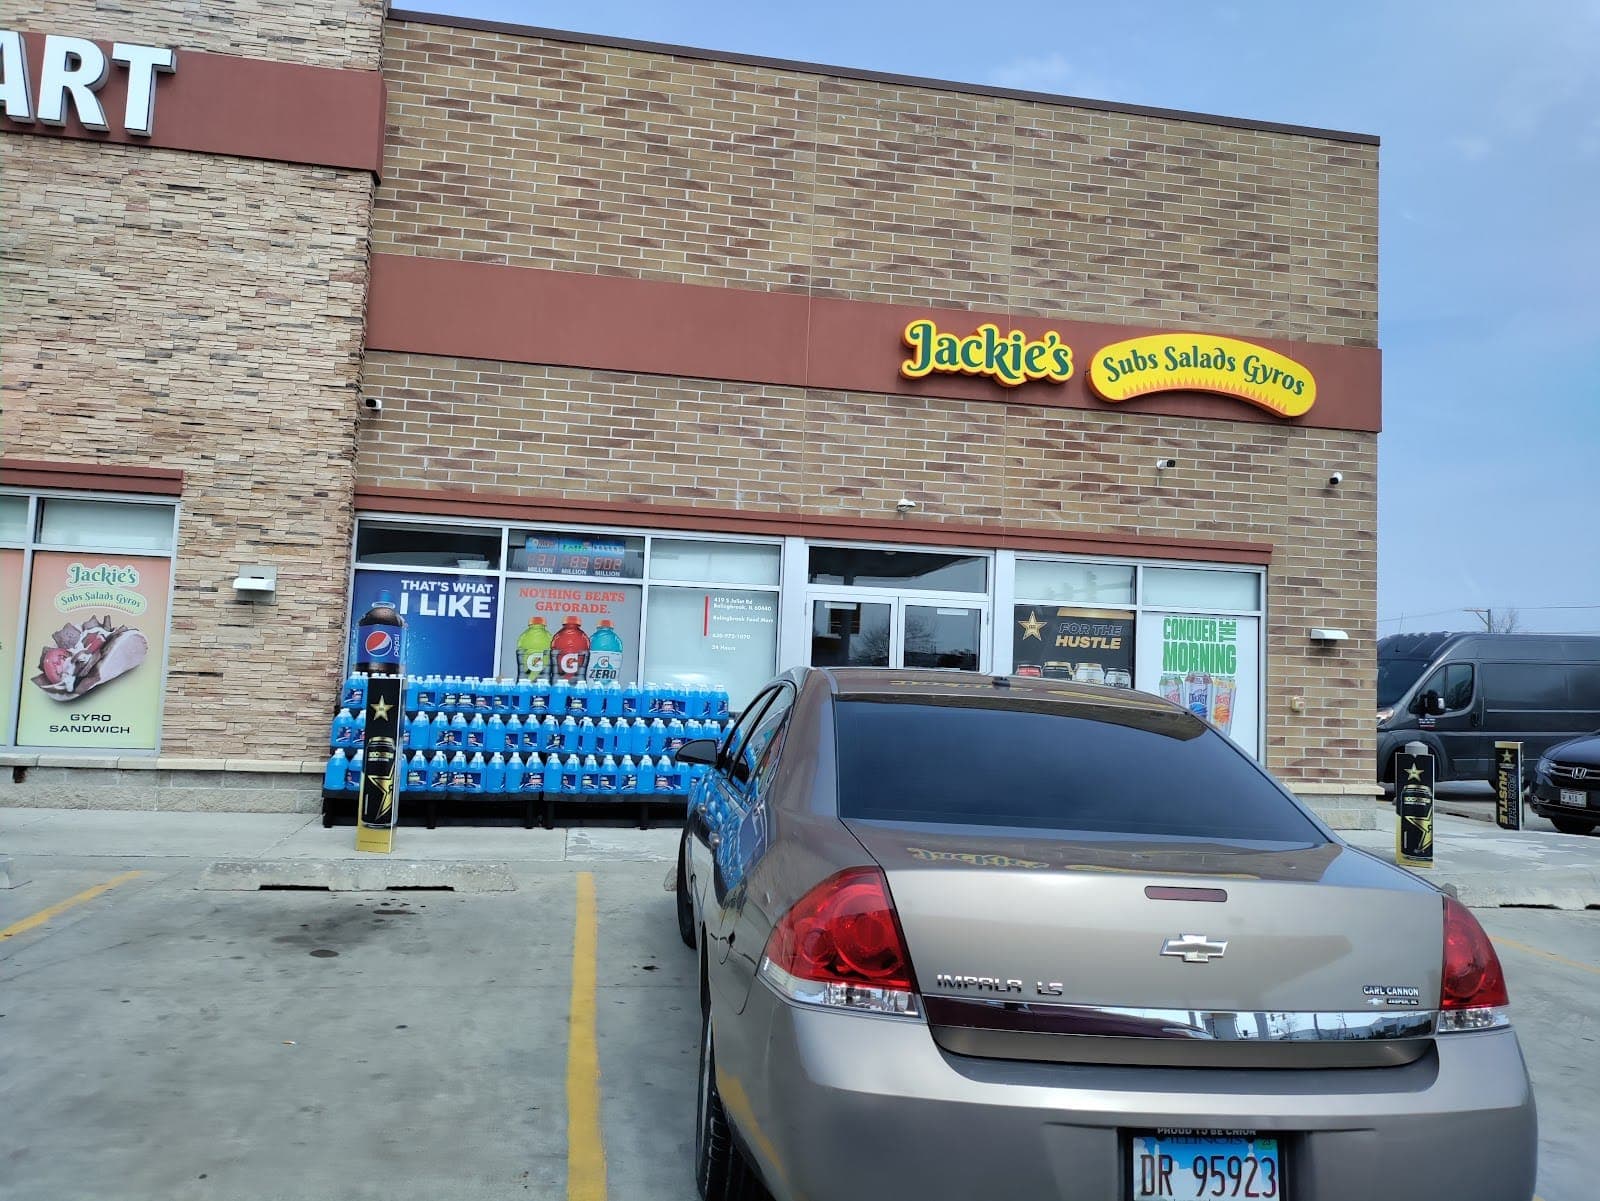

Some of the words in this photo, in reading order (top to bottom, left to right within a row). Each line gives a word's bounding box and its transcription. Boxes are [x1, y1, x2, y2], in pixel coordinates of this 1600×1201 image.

[904, 320, 1072, 382] Jackie's
[1102, 348, 1158, 383] Subs
[1164, 345, 1237, 373] Salads
[1242, 354, 1306, 397] Gyros
[69, 566, 136, 586] Jackie's
[527, 566, 553, 574] MILLION
[401, 580, 449, 592] THAT'S
[452, 582, 494, 594] WHAT
[519, 587, 581, 601] NOTHING
[585, 591, 625, 603] BEATS
[61, 593, 83, 605] Subs
[85, 591, 113, 601] Salads
[116, 593, 141, 607] Gyros
[400, 592, 409, 615] I
[419, 593, 491, 618] LIKE
[1059, 622, 1090, 635] FOR
[1092, 624, 1122, 636] THE
[1163, 618, 1217, 642] CONQUER
[1219, 618, 1237, 643] THE
[393, 633, 401, 657] pepsi
[1055, 635, 1122, 650] HUSTLE
[560, 653, 579, 674] G
[597, 656, 609, 668] G
[1162, 641, 1237, 674] MORNING
[589, 669, 617, 680] ZERO
[70, 713, 112, 722] GYRO
[49, 725, 130, 734] SANDWICH
[1498, 769, 1508, 825] HUSTLE
[937, 974, 1022, 993] IMPALA
[1037, 981, 1063, 995] LS
[1363, 986, 1385, 995] CARL
[1386, 987, 1419, 996] CANNON
[1141, 1154, 1173, 1196] DR
[1192, 1155, 1277, 1198] 95923
